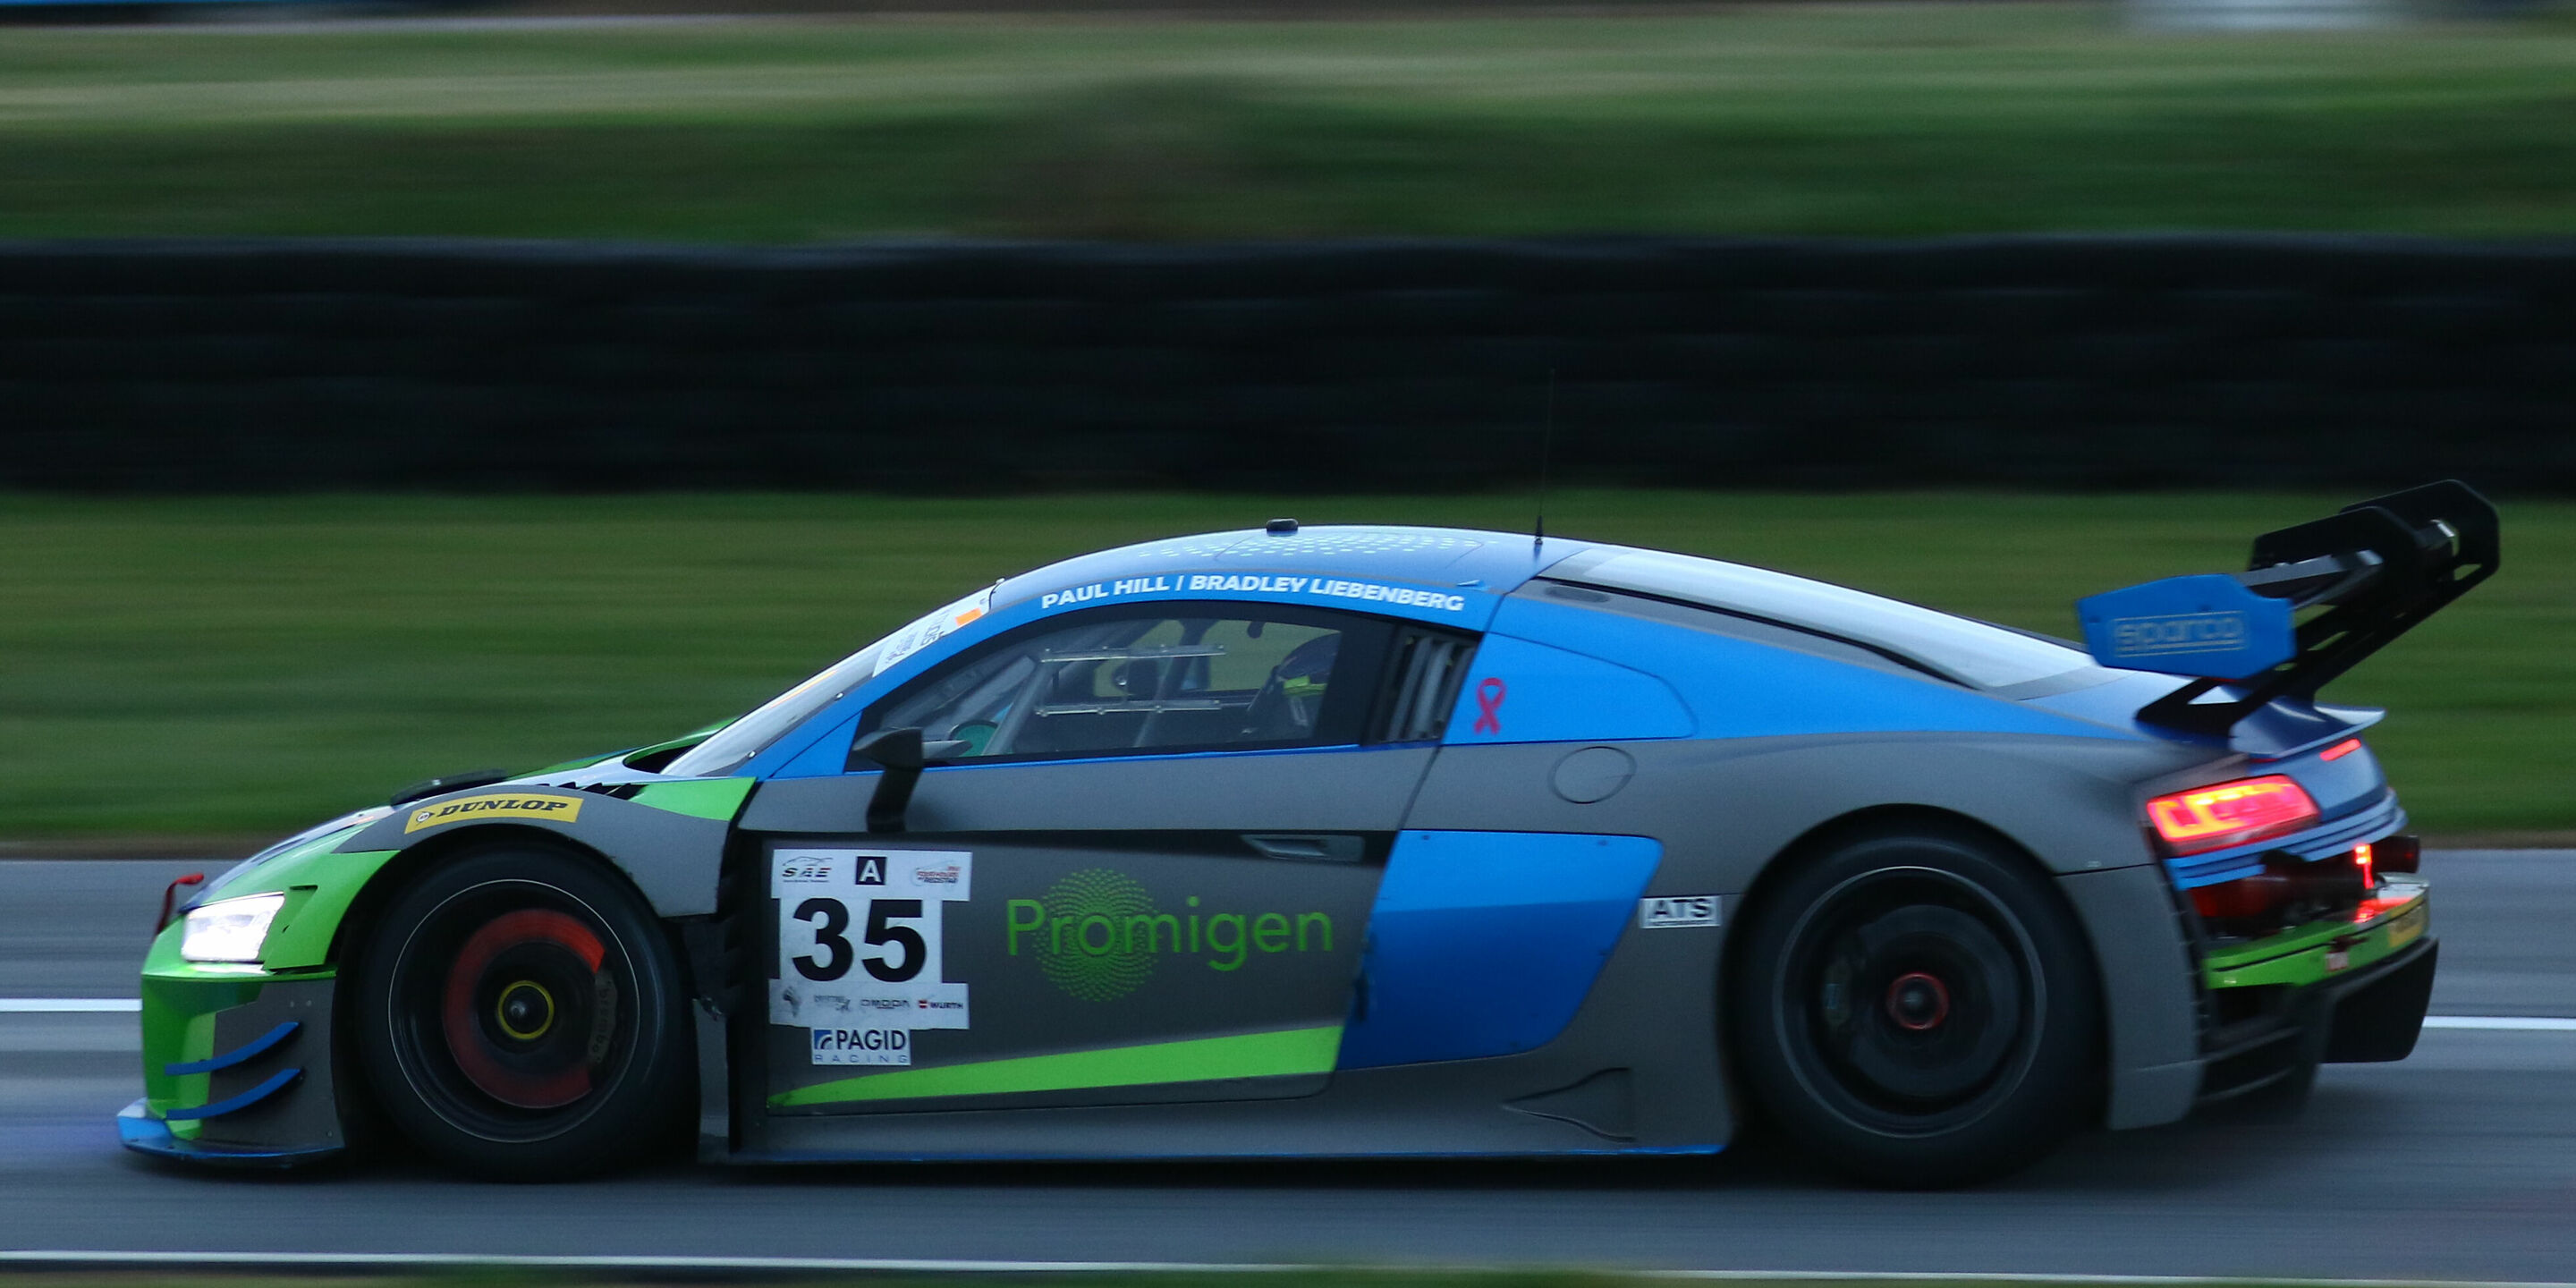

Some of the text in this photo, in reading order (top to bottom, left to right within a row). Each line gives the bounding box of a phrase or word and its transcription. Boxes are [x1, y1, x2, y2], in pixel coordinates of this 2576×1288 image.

[1042, 584, 1109, 609] PAUL
[1114, 576, 1170, 596] HILL
[1189, 574, 1309, 593] BRADLEY
[1309, 579, 1465, 611] LIEBENBERG
[2114, 617, 2244, 649] sparco
[436, 800, 569, 818] DUNLOP
[782, 868, 832, 878] SAE
[859, 860, 883, 883] A
[1648, 898, 1712, 919] ATS
[792, 898, 926, 982] 35
[1007, 896, 1334, 971] Promigen
[837, 1030, 906, 1050] PAGID
[815, 1054, 910, 1063] RACING
